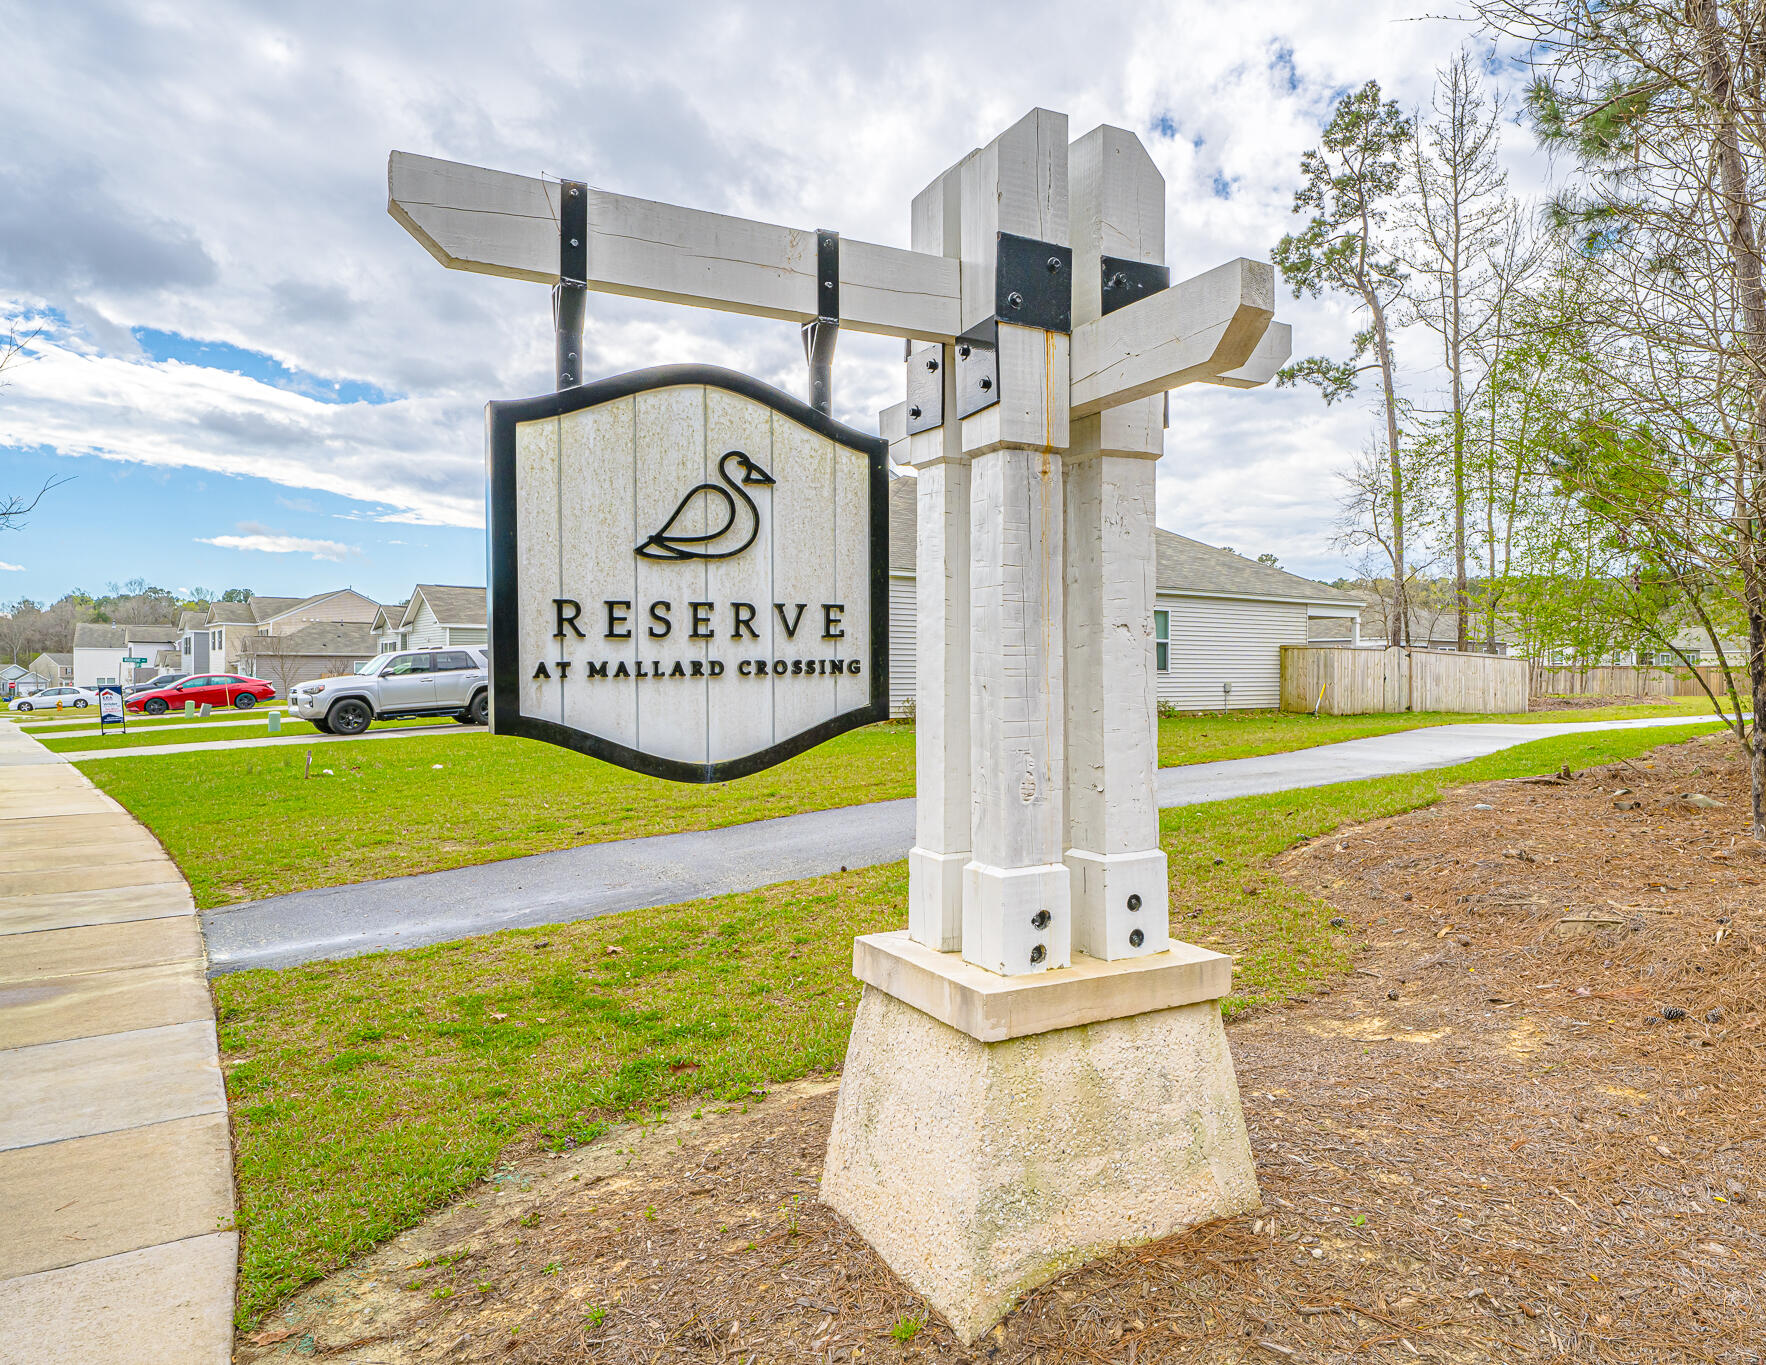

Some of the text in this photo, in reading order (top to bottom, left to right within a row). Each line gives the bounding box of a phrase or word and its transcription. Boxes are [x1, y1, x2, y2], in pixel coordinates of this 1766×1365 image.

[552, 598, 845, 639] RESERVE
[532, 659, 862, 679] AT MALLARD CROSSING
